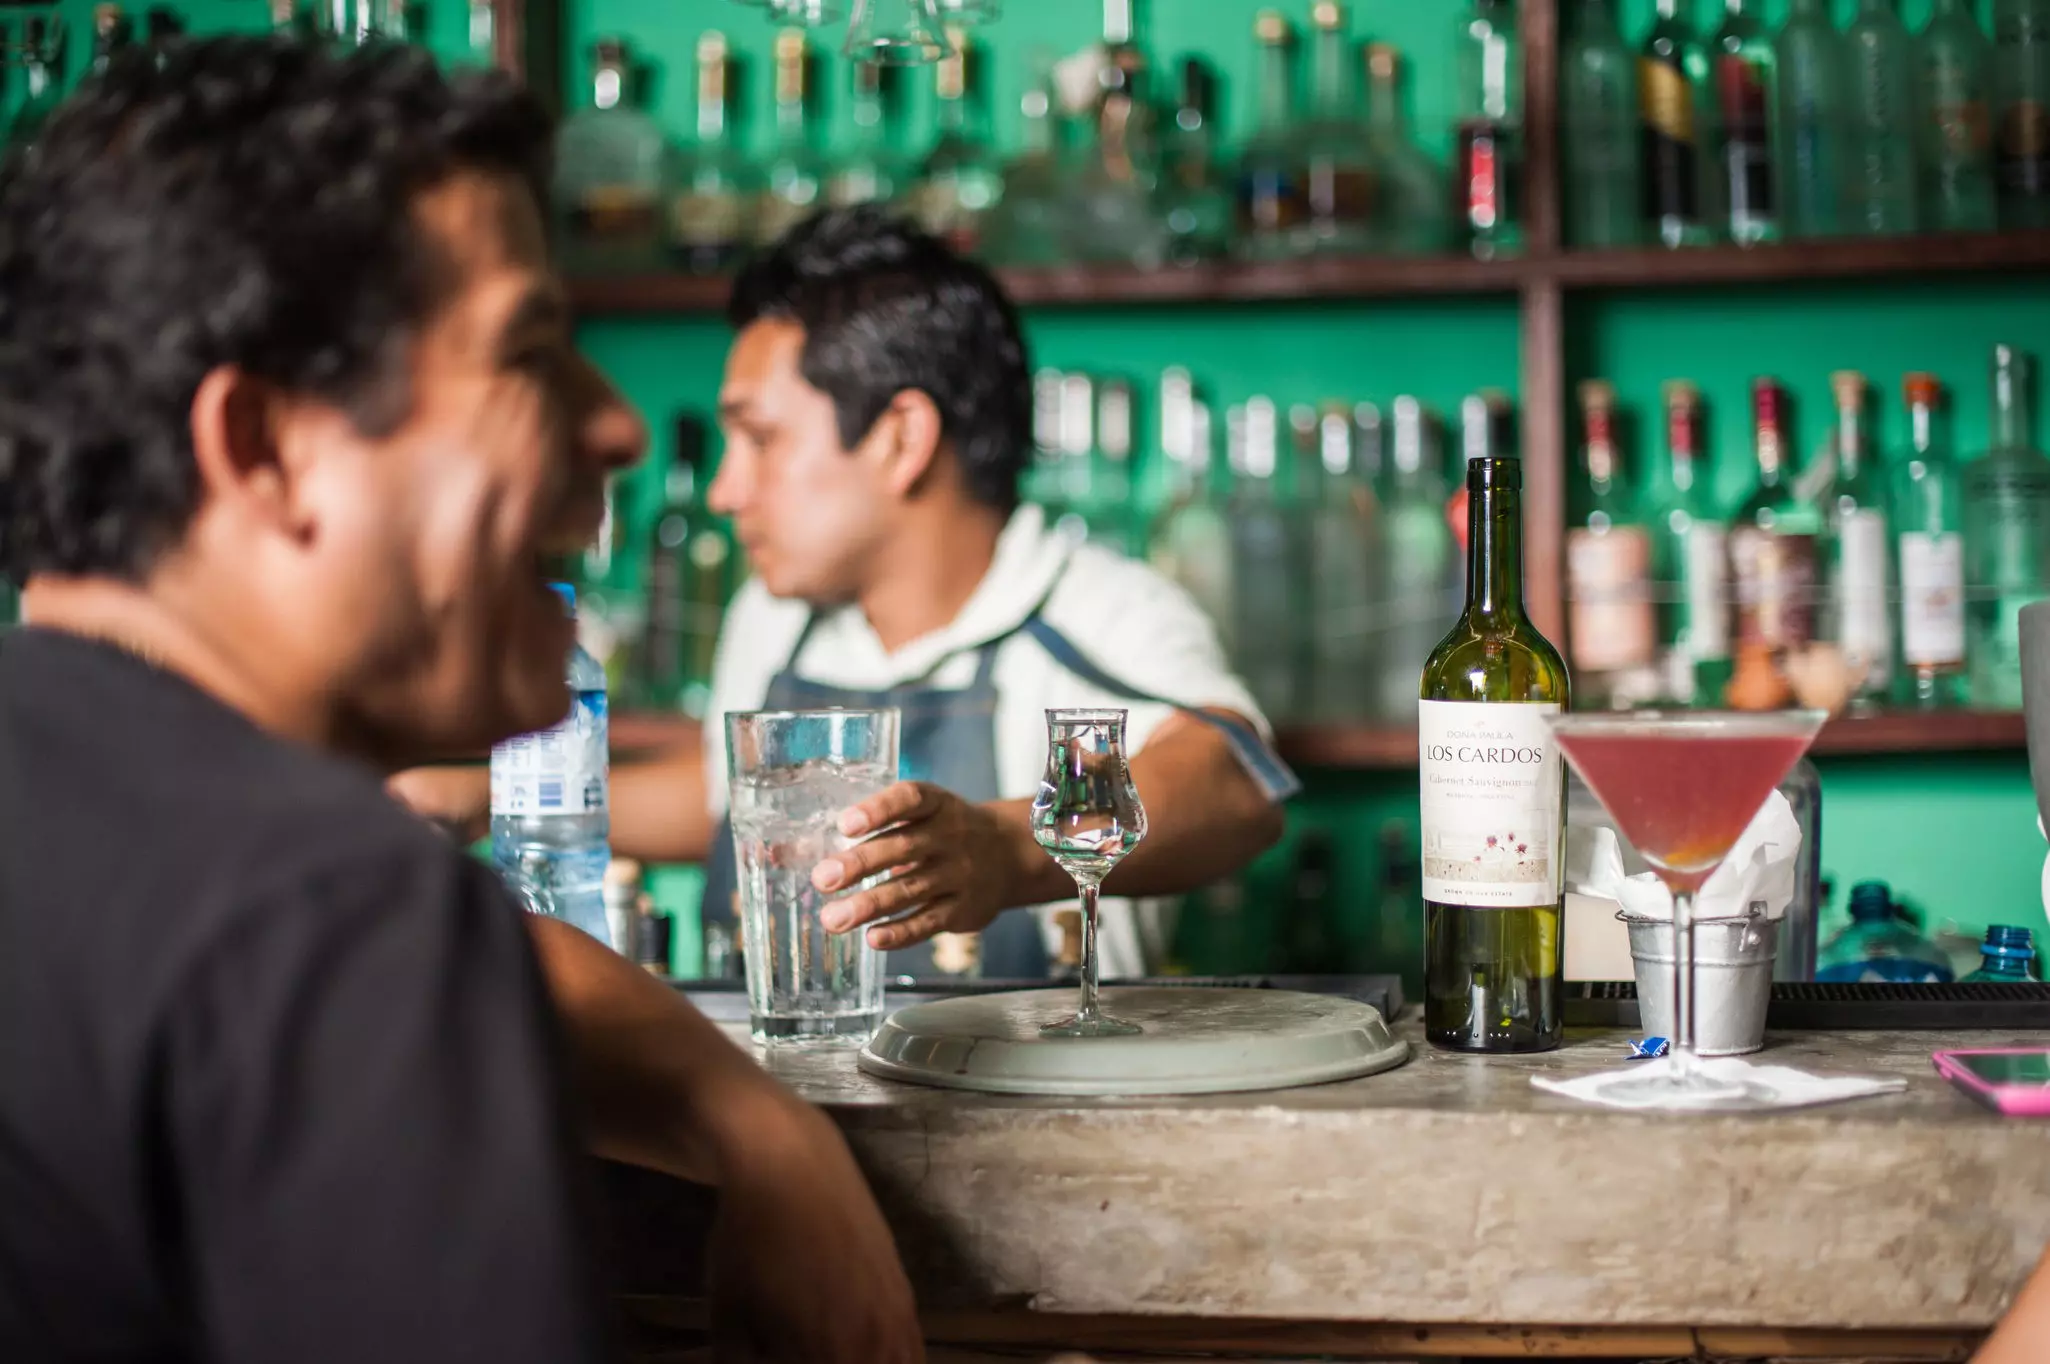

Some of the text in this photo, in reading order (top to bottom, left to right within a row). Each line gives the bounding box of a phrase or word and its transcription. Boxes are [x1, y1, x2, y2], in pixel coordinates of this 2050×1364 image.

[1427, 744, 1542, 763] LOS CARDOS
[1467, 775, 1522, 788] Sauvignon
